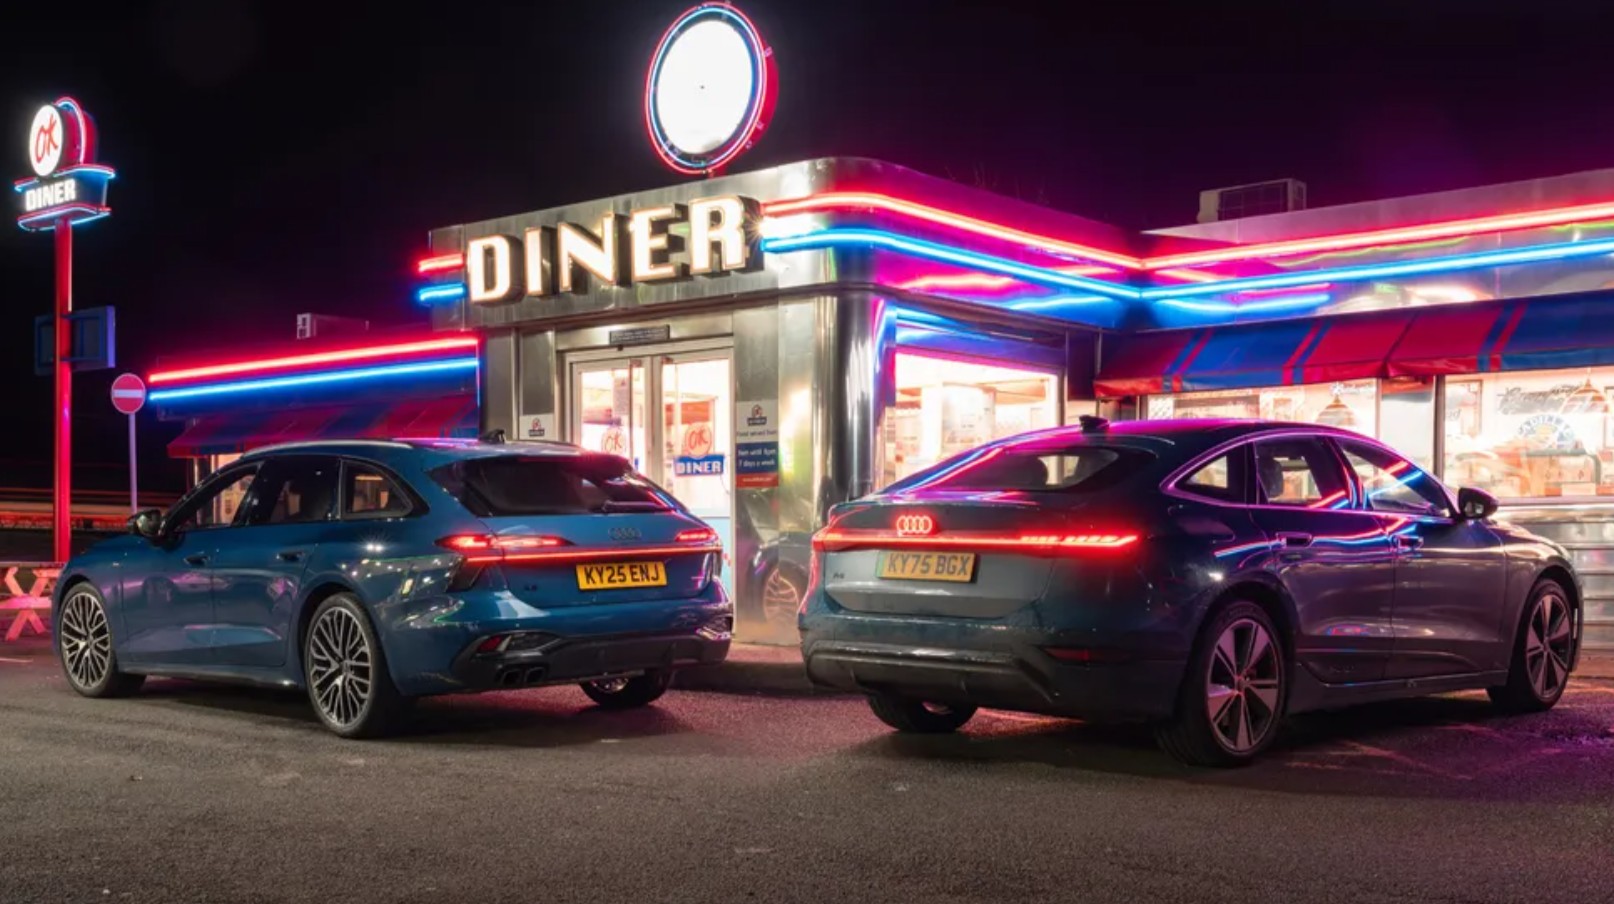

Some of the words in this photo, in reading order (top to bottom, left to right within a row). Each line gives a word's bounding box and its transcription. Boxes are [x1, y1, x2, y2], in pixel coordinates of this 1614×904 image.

[36, 114, 58, 163] OK
[25, 178, 76, 212] DINER
[467, 195, 747, 302] DINER
[690, 429, 708, 449] OK
[675, 460, 721, 474] DINER
[584, 565, 627, 584] KY25
[630, 563, 660, 582] ENJ
[887, 553, 932, 574] KY75
[935, 554, 970, 576] BGX
